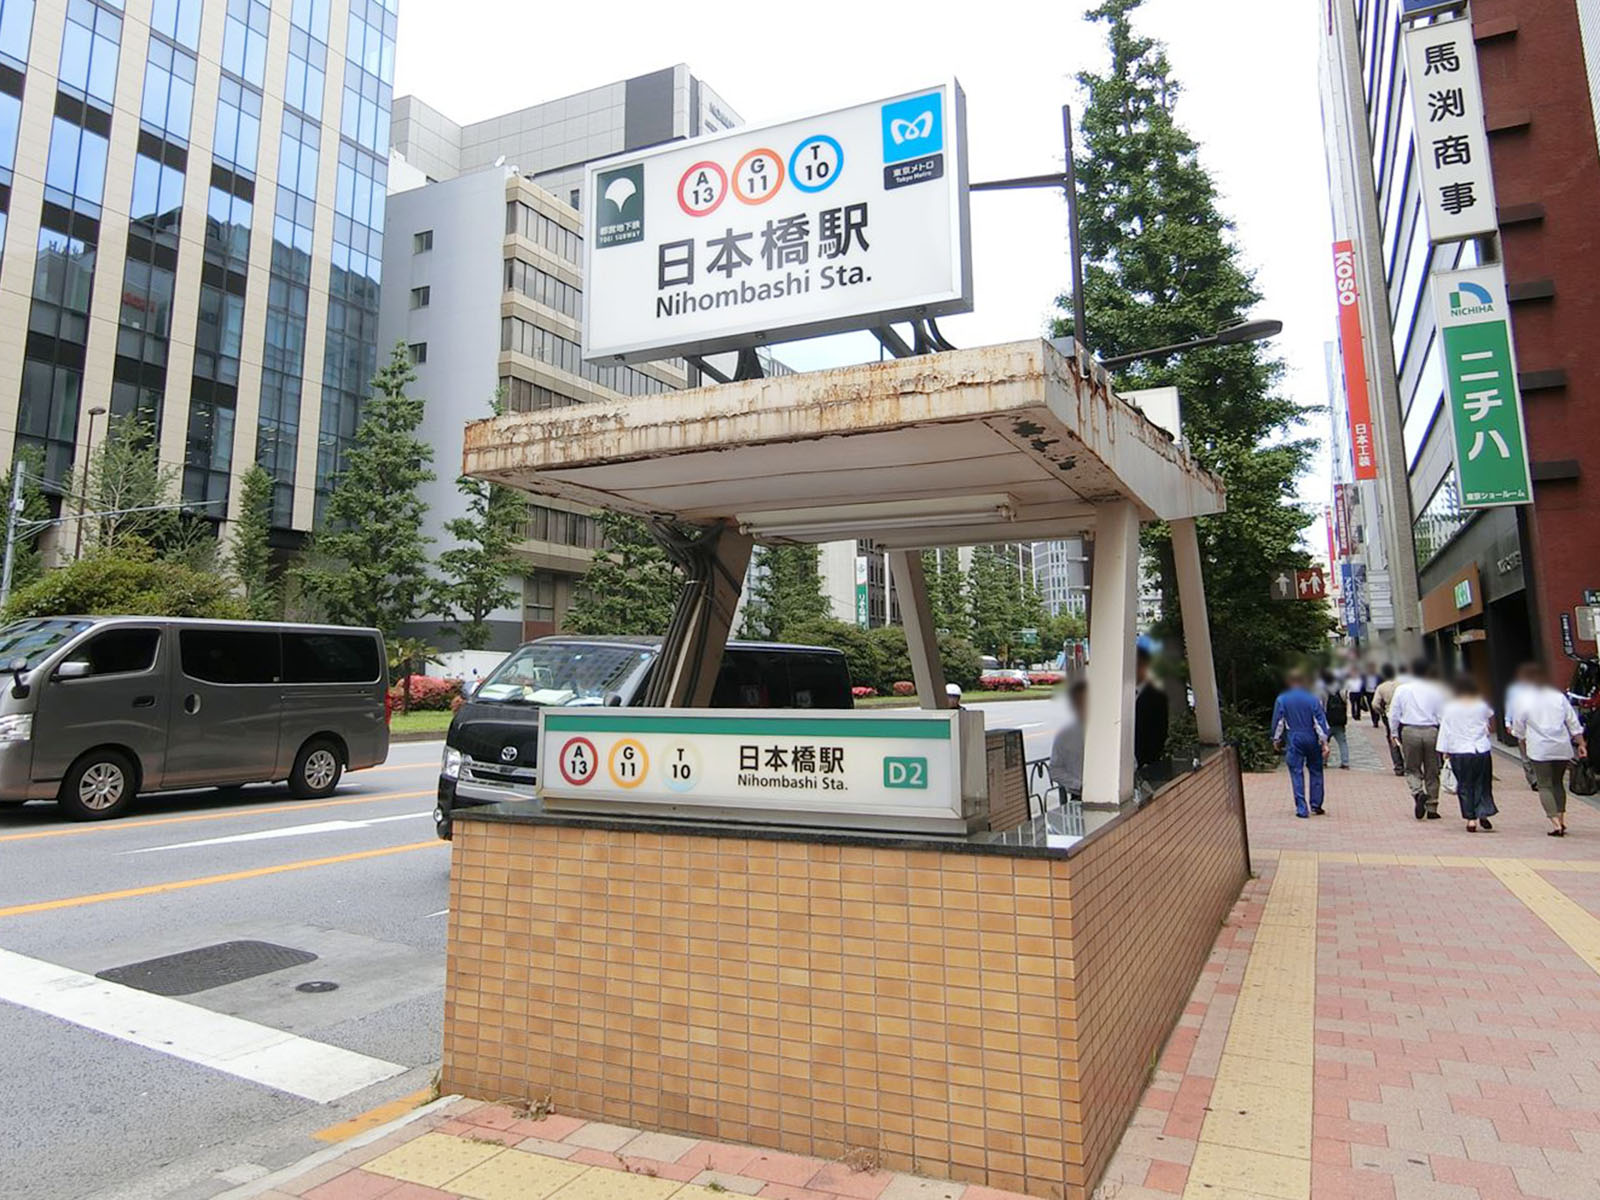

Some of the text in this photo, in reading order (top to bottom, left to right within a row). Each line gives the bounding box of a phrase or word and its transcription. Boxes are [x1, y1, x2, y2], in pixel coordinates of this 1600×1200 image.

[1423, 41, 1477, 215] 馬渕商事
[810, 144, 820, 160] T
[750, 157, 764, 174] G
[805, 163, 828, 182] 10
[893, 160, 934, 177] 東京メトロ
[696, 171, 709, 186] A
[747, 175, 769, 194] 11
[692, 188, 714, 206] 13
[658, 202, 869, 290] 日本橋駅
[1334, 251, 1354, 306] KOSO
[656, 263, 872, 319] Nihombashi Sta.
[1450, 304, 1494, 317] NICHIHA
[1460, 350, 1510, 461] ニチハ
[574, 746, 584, 758] A
[623, 746, 635, 760] G
[676, 748, 686, 762] T
[738, 745, 845, 774] 日本橋駅
[571, 760, 588, 776] 13
[620, 762, 637, 777] 11
[671, 764, 691, 779] 10
[888, 762, 924, 785] D2
[737, 773, 849, 791] Nihombashi Sta.
